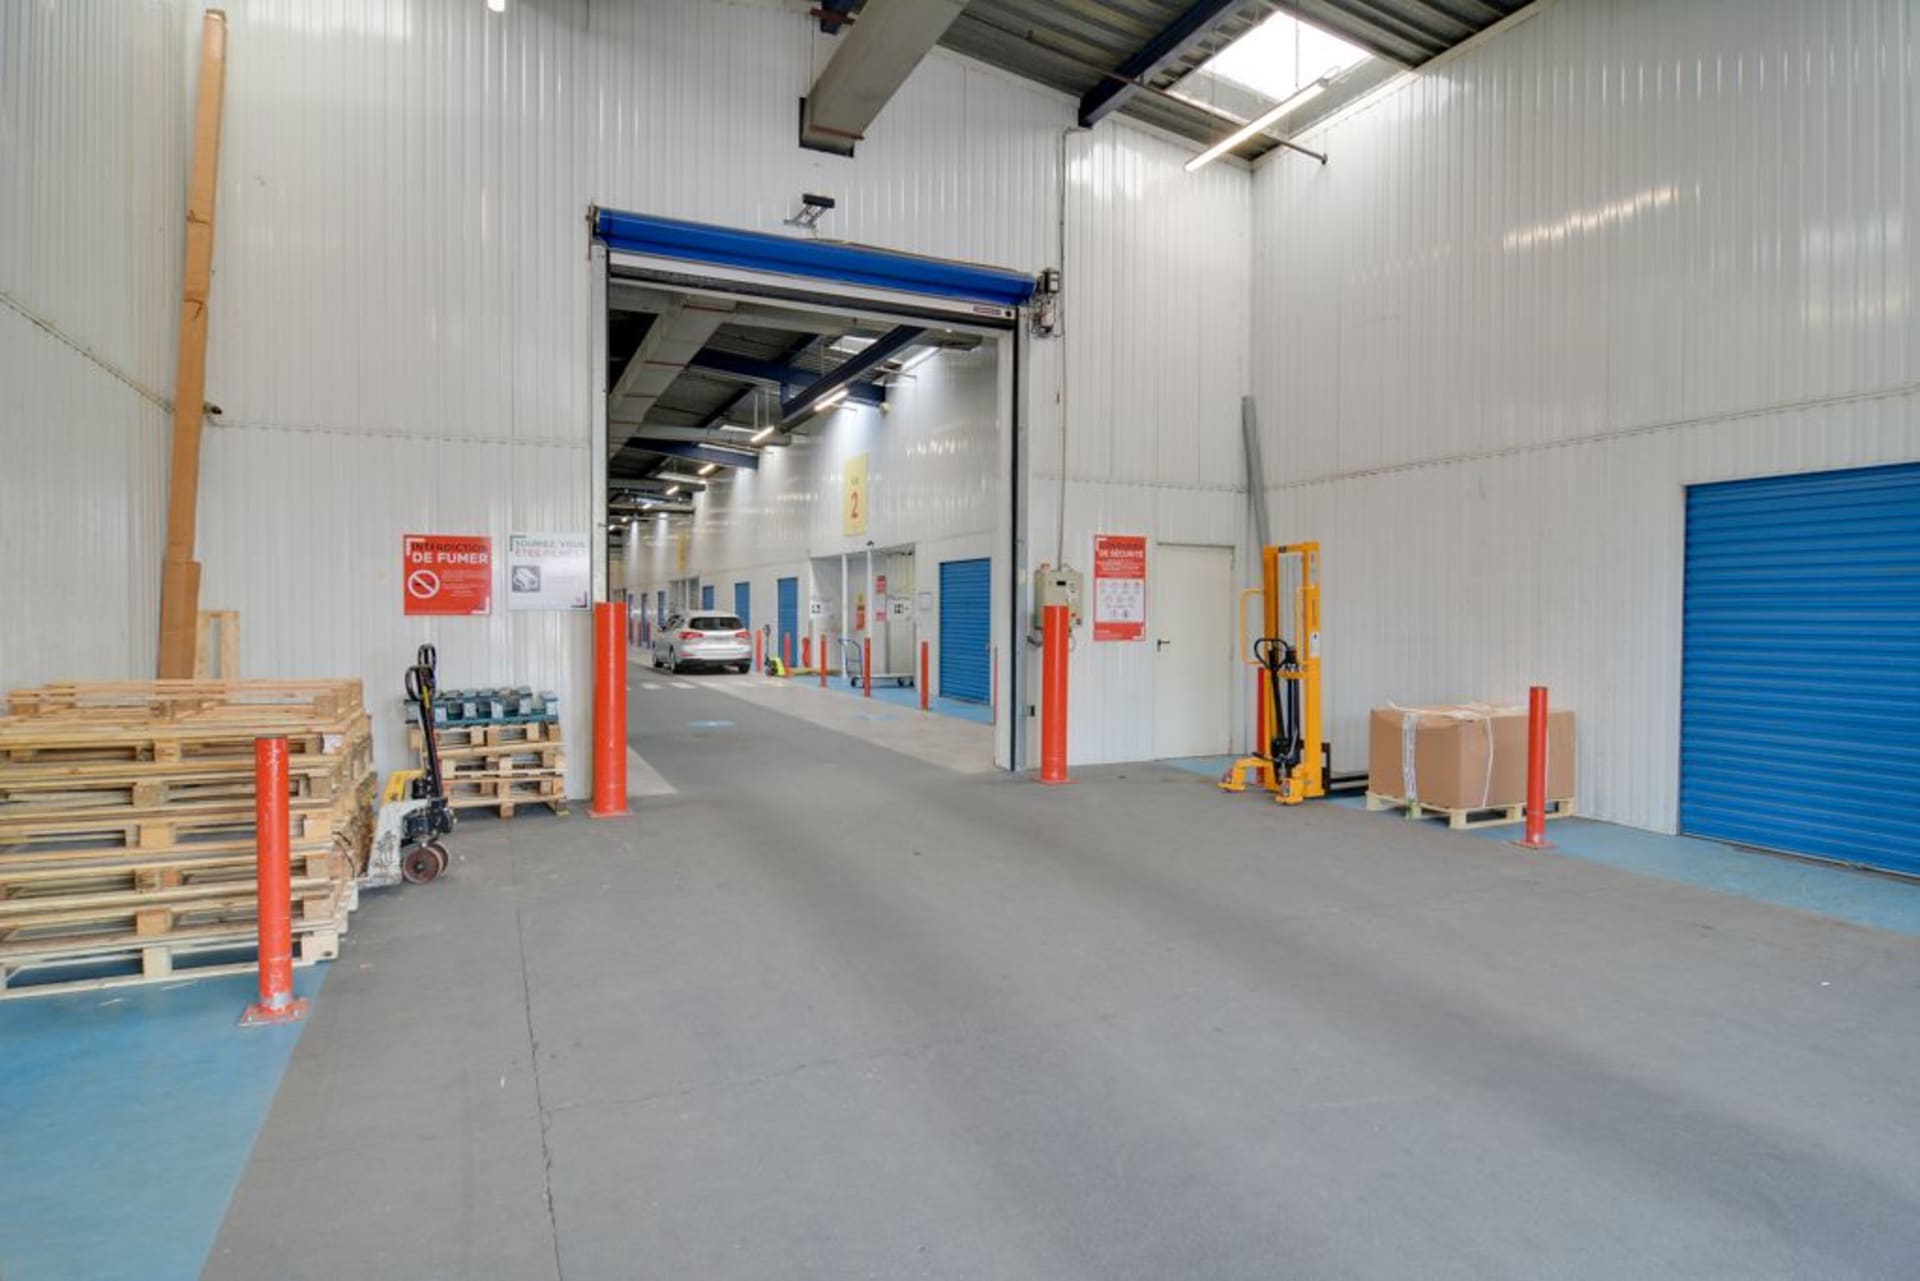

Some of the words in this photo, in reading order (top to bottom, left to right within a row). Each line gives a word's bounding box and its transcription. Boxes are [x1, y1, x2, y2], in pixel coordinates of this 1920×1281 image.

[850, 491, 859, 519] 2
[412, 551, 433, 564] DE
[437, 551, 489, 566] FUMER
